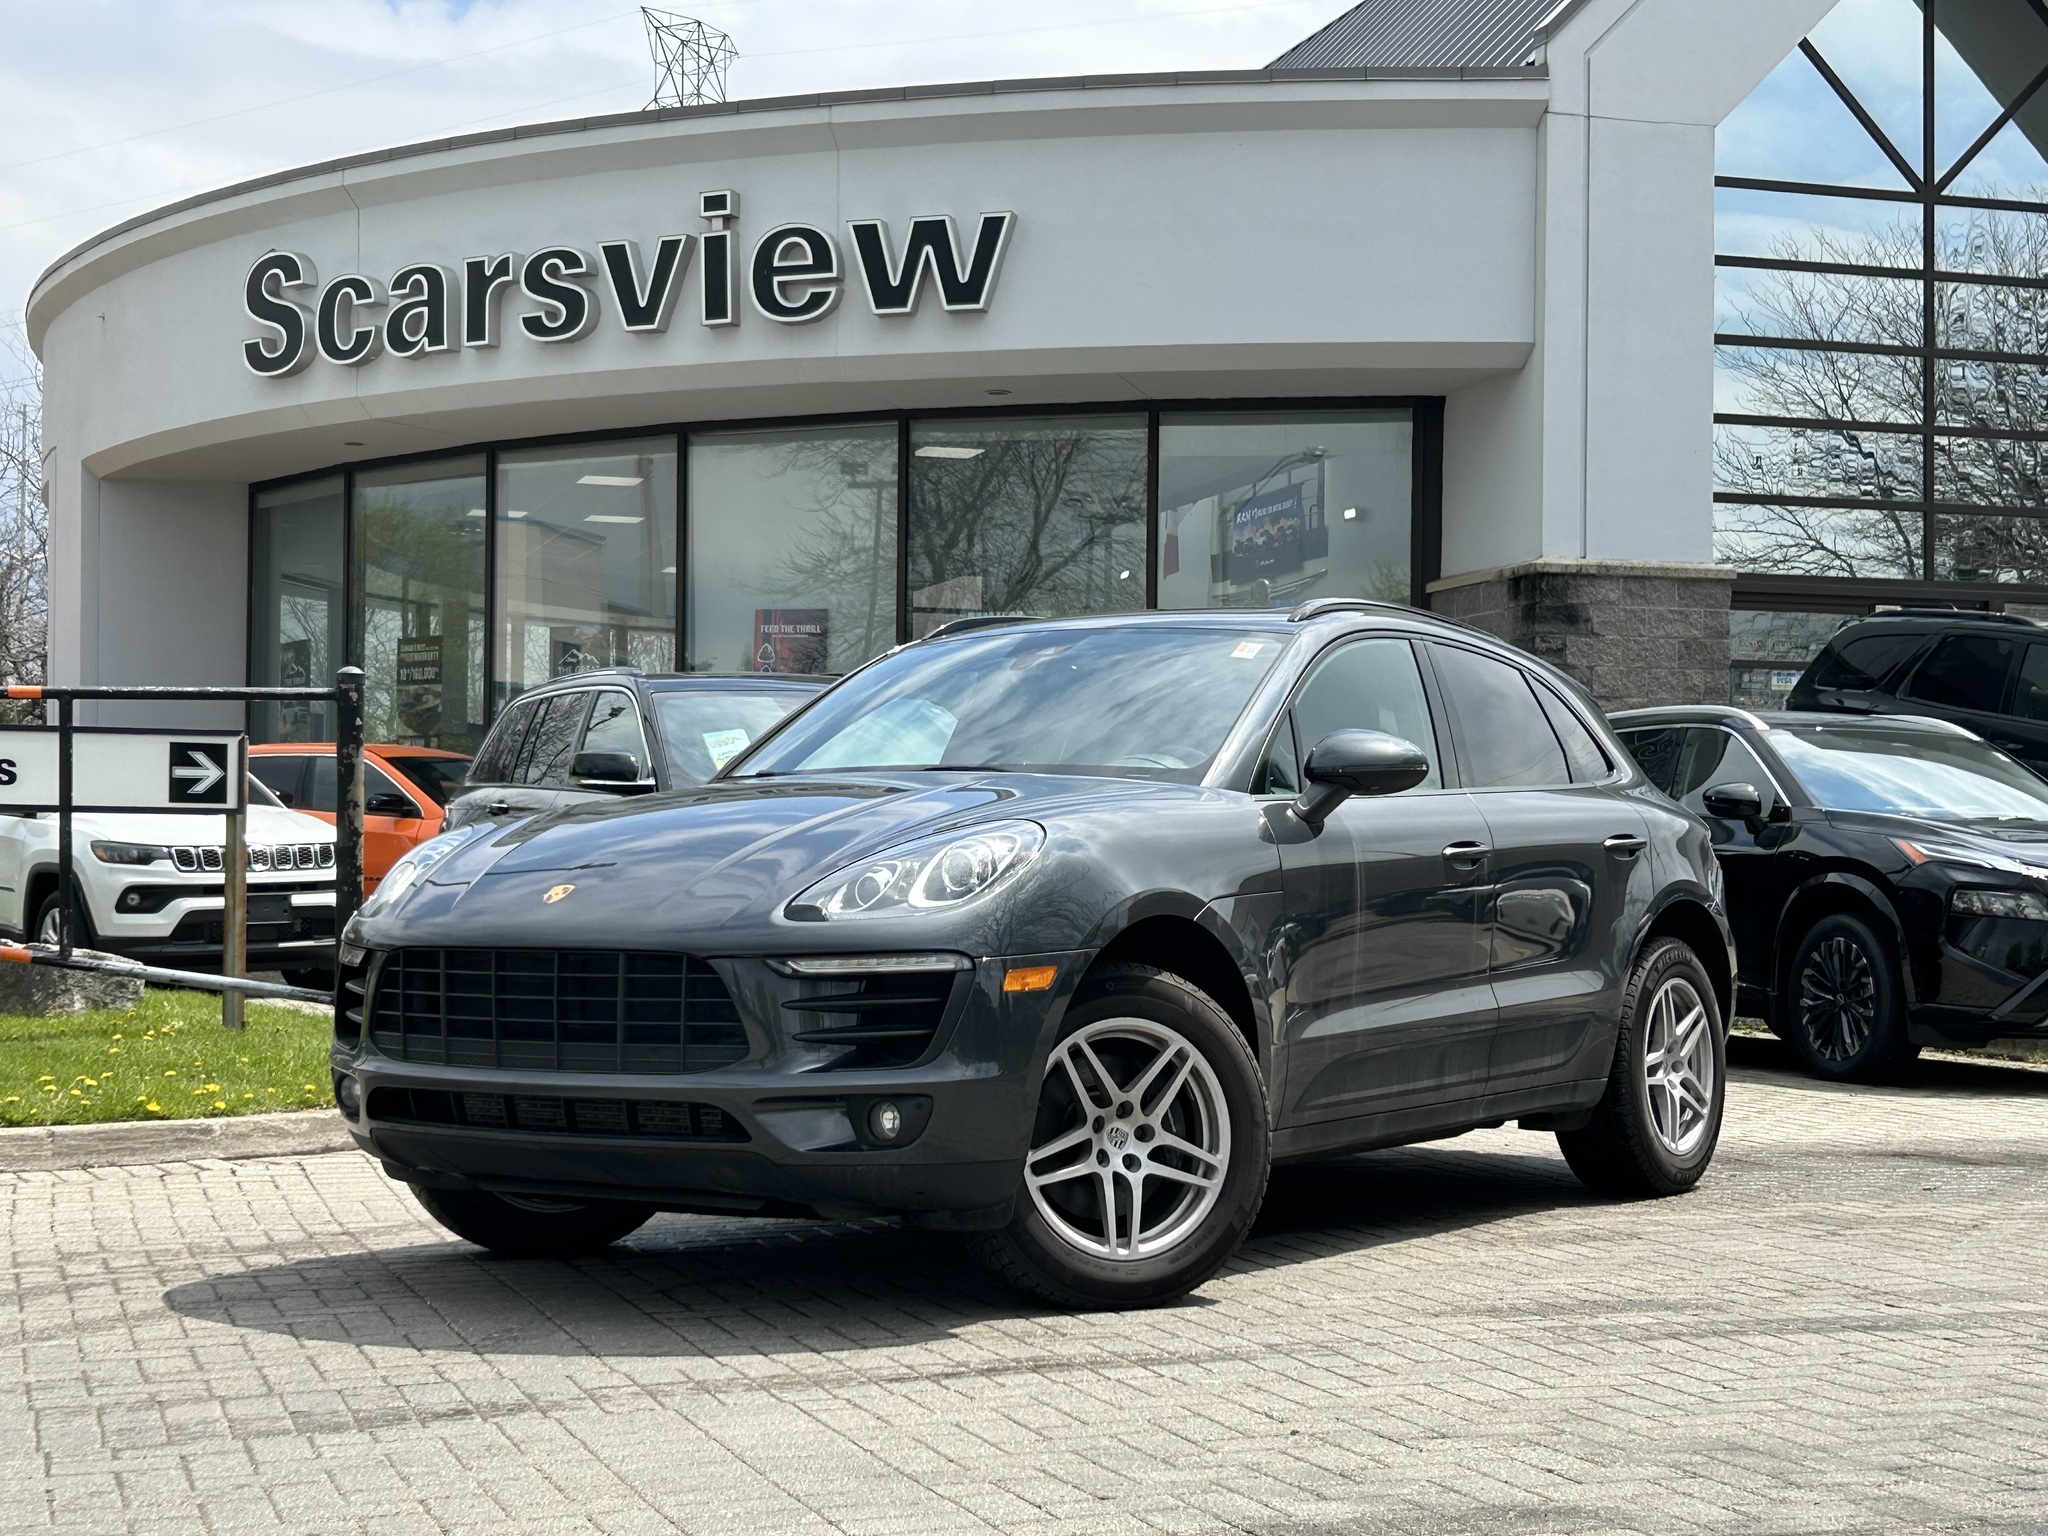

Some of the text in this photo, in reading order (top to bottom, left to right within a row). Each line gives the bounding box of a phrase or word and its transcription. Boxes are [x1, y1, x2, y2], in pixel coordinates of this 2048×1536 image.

[242, 189, 1015, 377] Scarsview
[760, 624, 822, 634] FEED THE THRILL
[1657, 950, 1692, 971] MICHELIN
